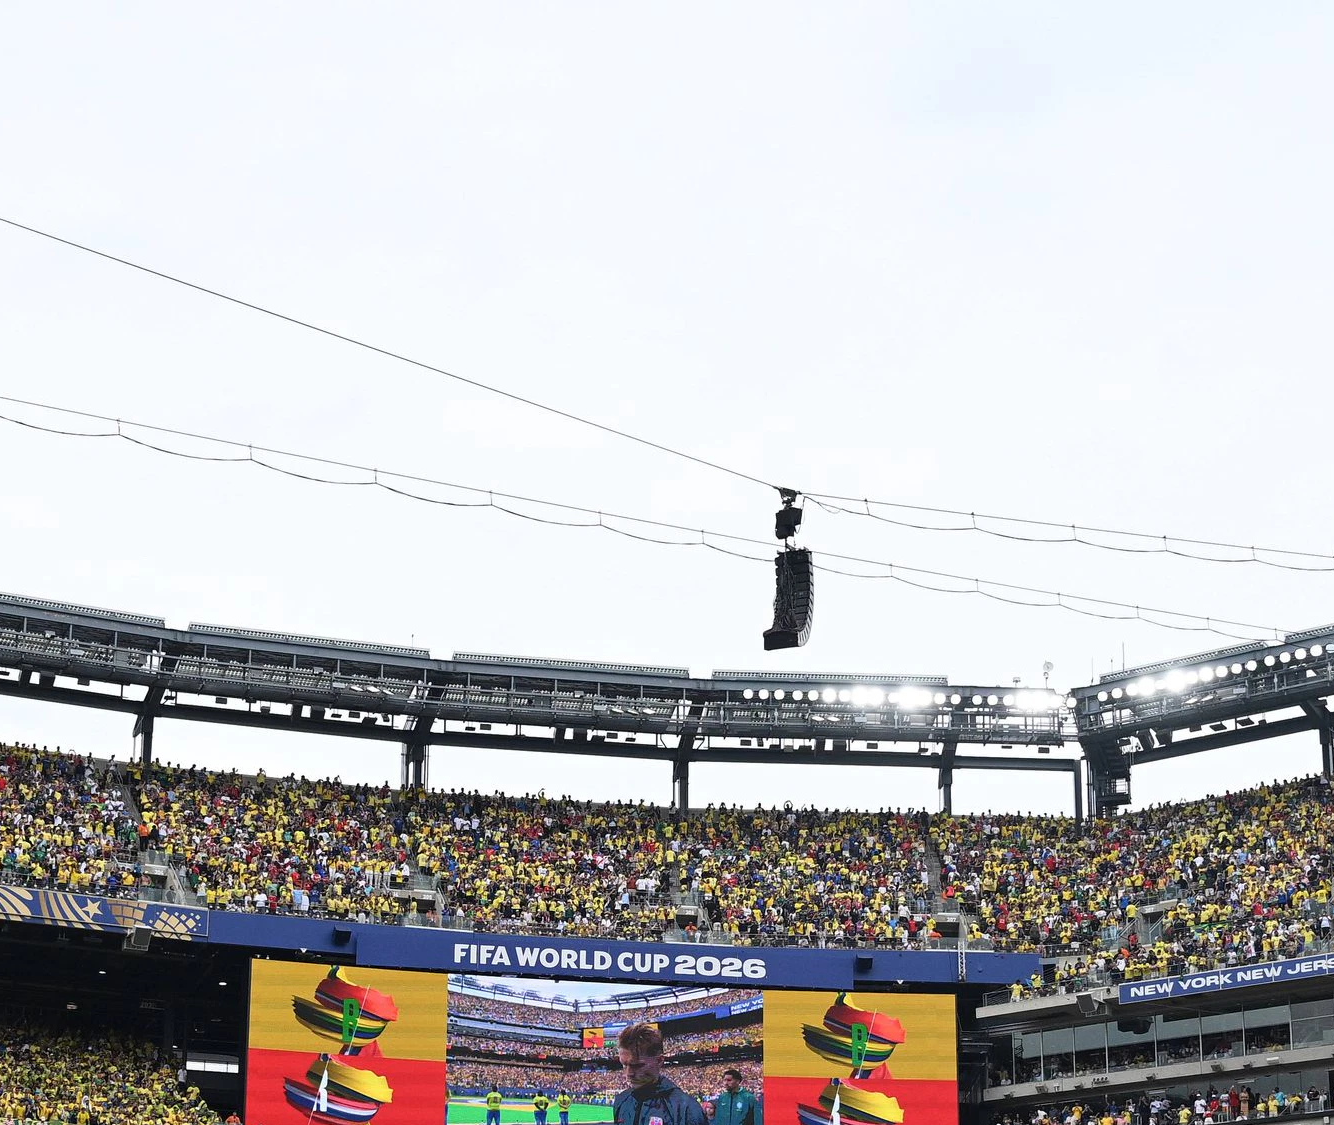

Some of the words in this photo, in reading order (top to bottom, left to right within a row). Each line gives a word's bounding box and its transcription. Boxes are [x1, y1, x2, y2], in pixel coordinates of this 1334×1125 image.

[453, 943, 512, 967] FIFA
[516, 946, 613, 971] WORLD
[617, 951, 669, 974] CUP
[673, 954, 767, 980] 2026
[1130, 981, 1172, 998] NEW
[1178, 973, 1232, 990] YORK
[1237, 965, 1282, 982] NEW
[731, 1001, 750, 1011] NEW
